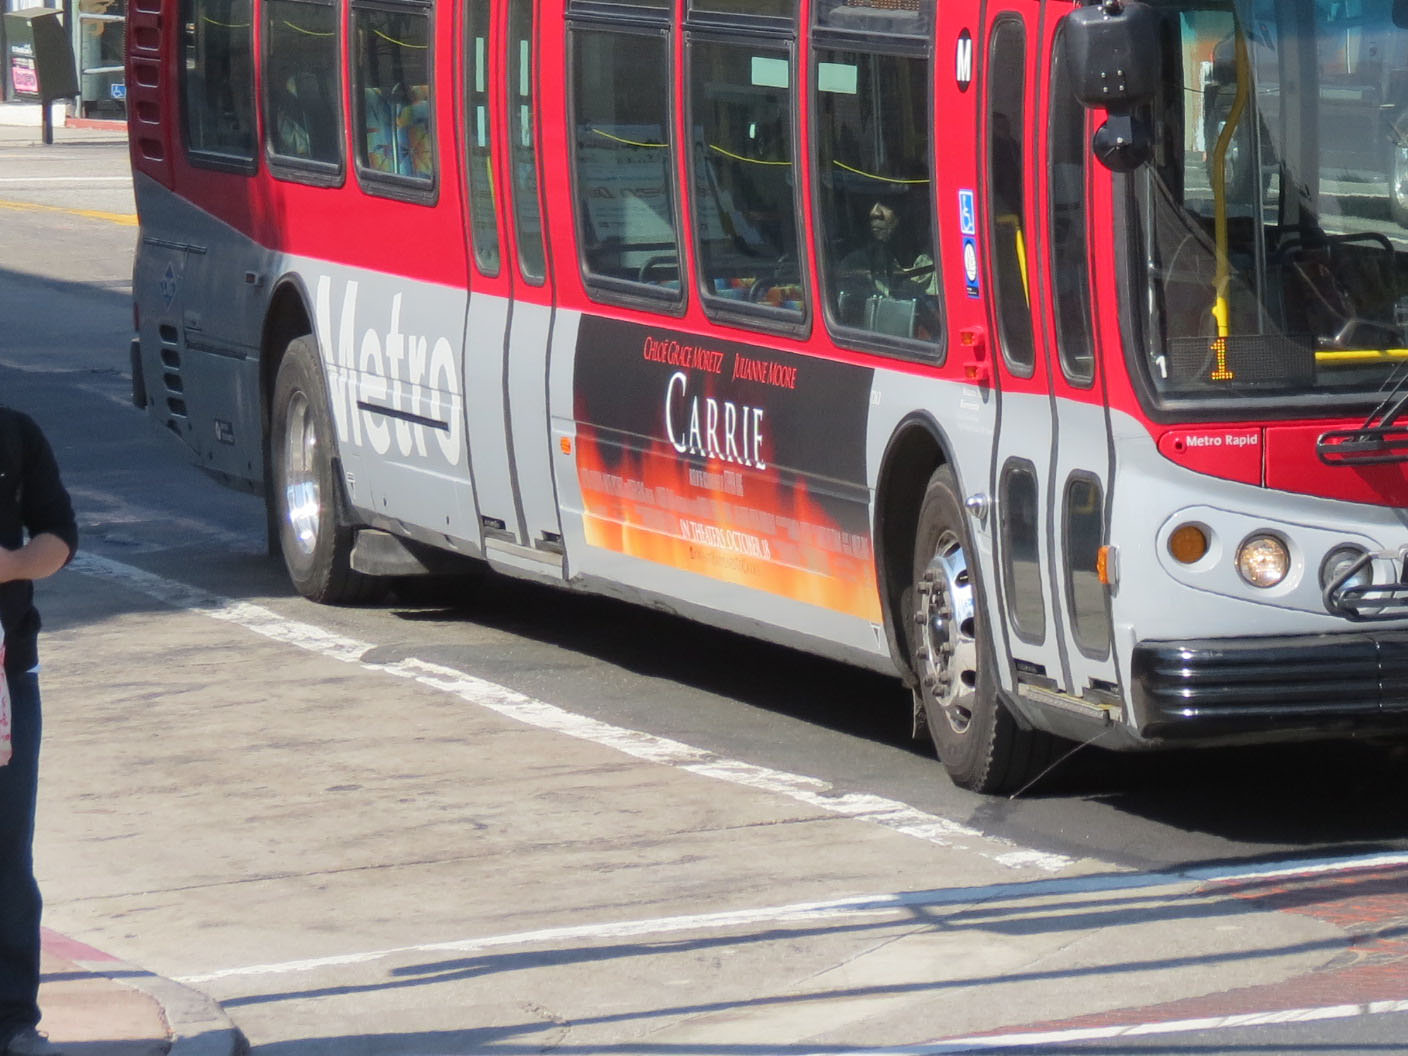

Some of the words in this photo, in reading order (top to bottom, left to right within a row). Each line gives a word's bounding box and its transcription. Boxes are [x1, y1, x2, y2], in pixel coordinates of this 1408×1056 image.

[316, 274, 461, 465] Metro
[768, 362, 798, 389] MOORE
[1210, 338, 1234, 380] 1
[665, 371, 767, 471] CARRIE
[1186, 435, 1222, 447] Metro
[1225, 434, 1258, 448] Rapid
